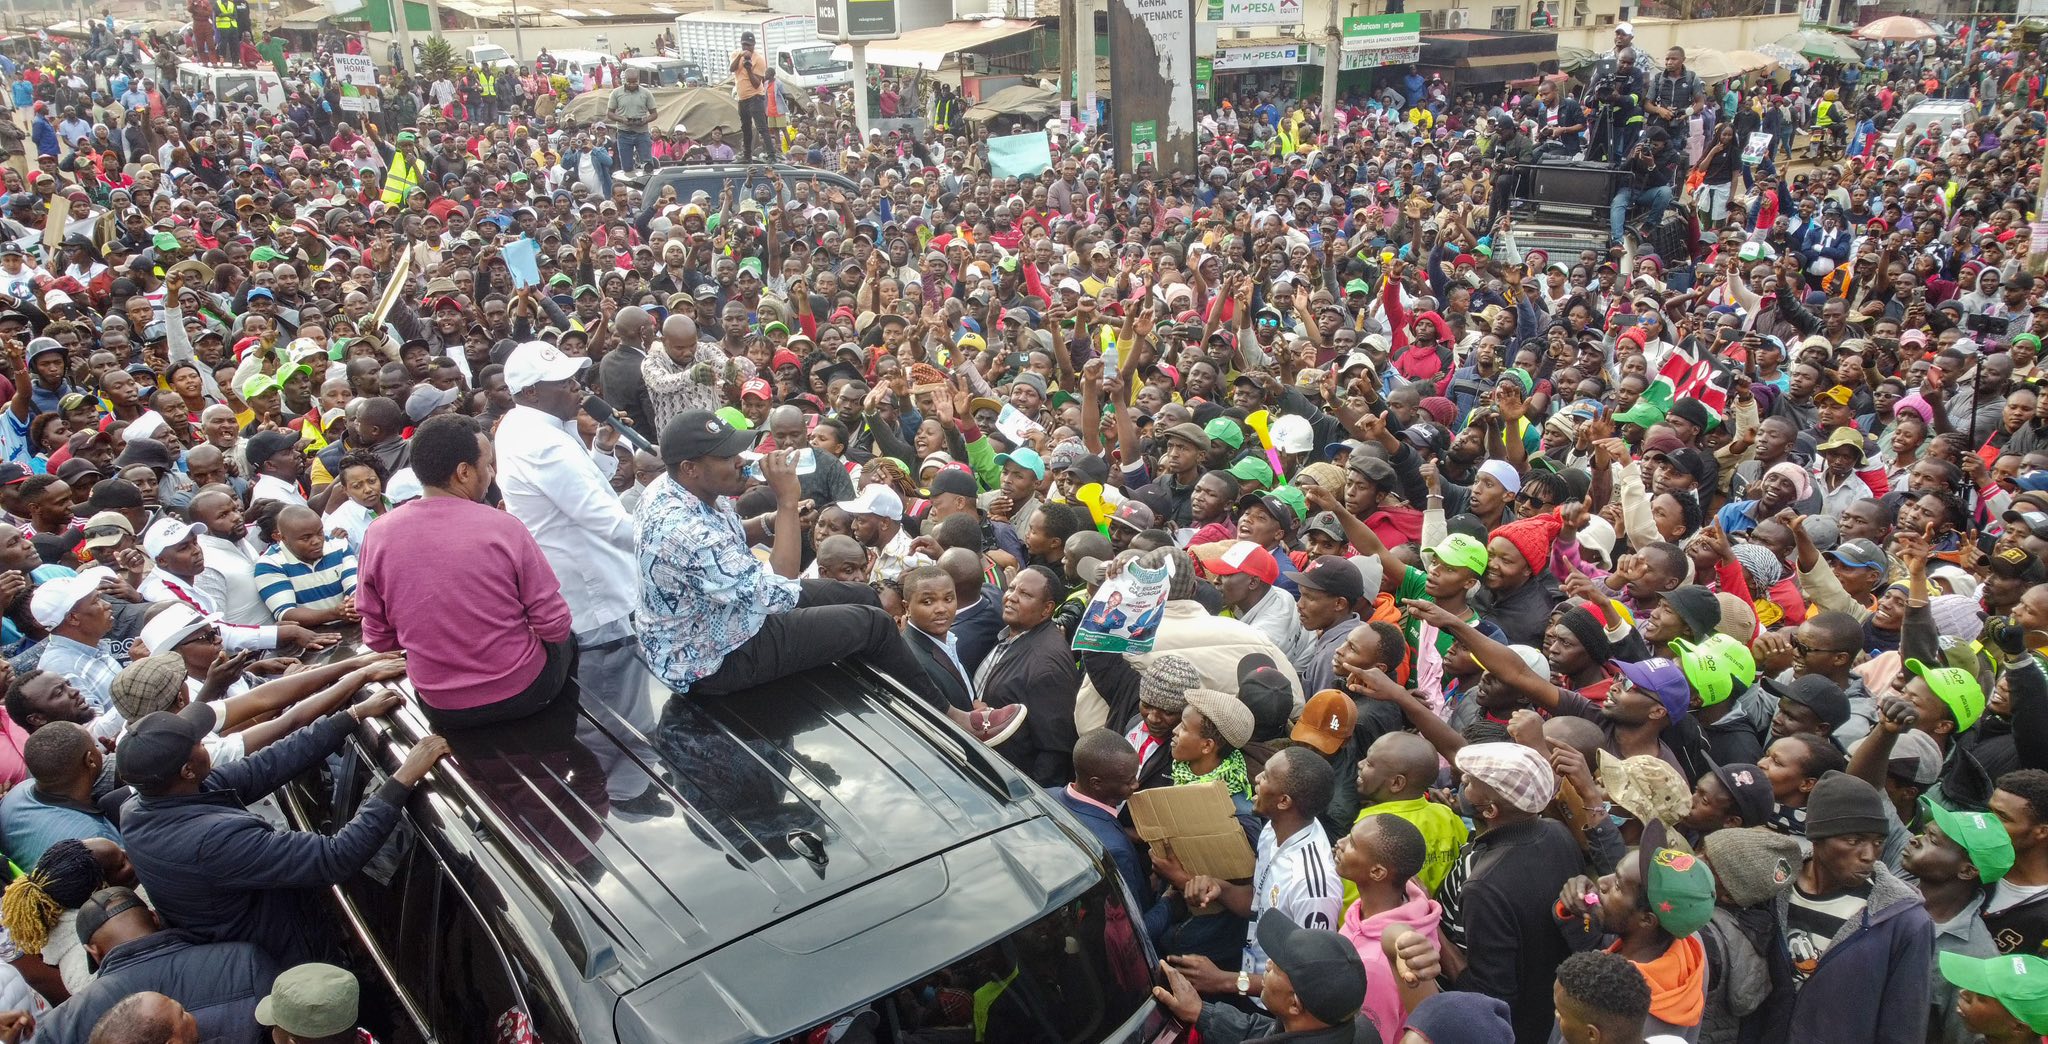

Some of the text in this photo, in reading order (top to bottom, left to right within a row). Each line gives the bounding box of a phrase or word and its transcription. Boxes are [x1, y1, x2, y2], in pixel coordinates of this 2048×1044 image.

[819, 7, 836, 19] NCBA
[1353, 22, 1381, 31] Safaricom
[335, 57, 371, 66] WELCOME
[1329, 714, 1340, 731] LA
